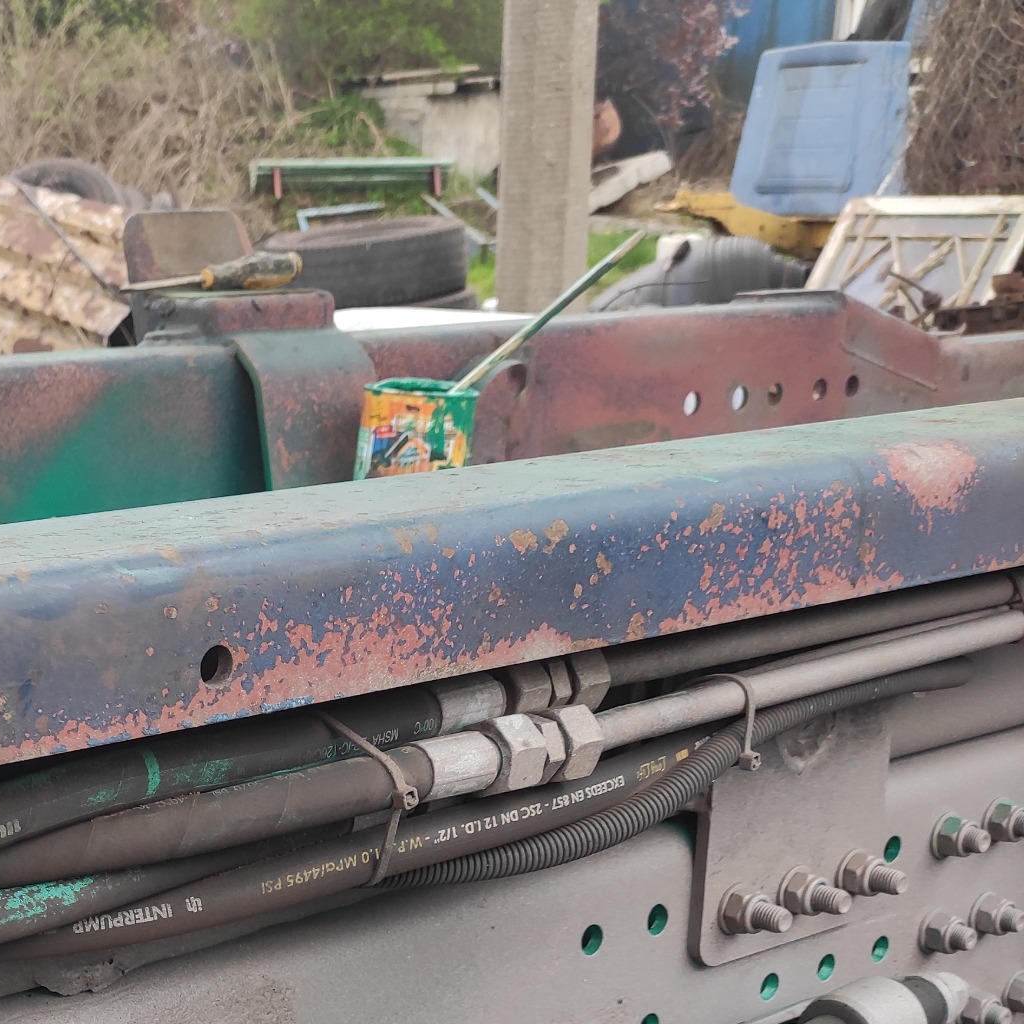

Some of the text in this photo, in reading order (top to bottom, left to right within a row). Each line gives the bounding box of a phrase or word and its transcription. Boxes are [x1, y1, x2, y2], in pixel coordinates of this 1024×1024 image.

[372, 728, 400, 746] MSHA
[571, 787, 584, 804] EN
[584, 775, 626, 799] EXCEEDS
[551, 791, 571, 811] 857
[502, 808, 519, 826] DN
[521, 802, 543, 819] 2SC
[483, 814, 498, 830] 12
[261, 879, 282, 895] PSI
[72, 902, 173, 934] INTERPUMP
